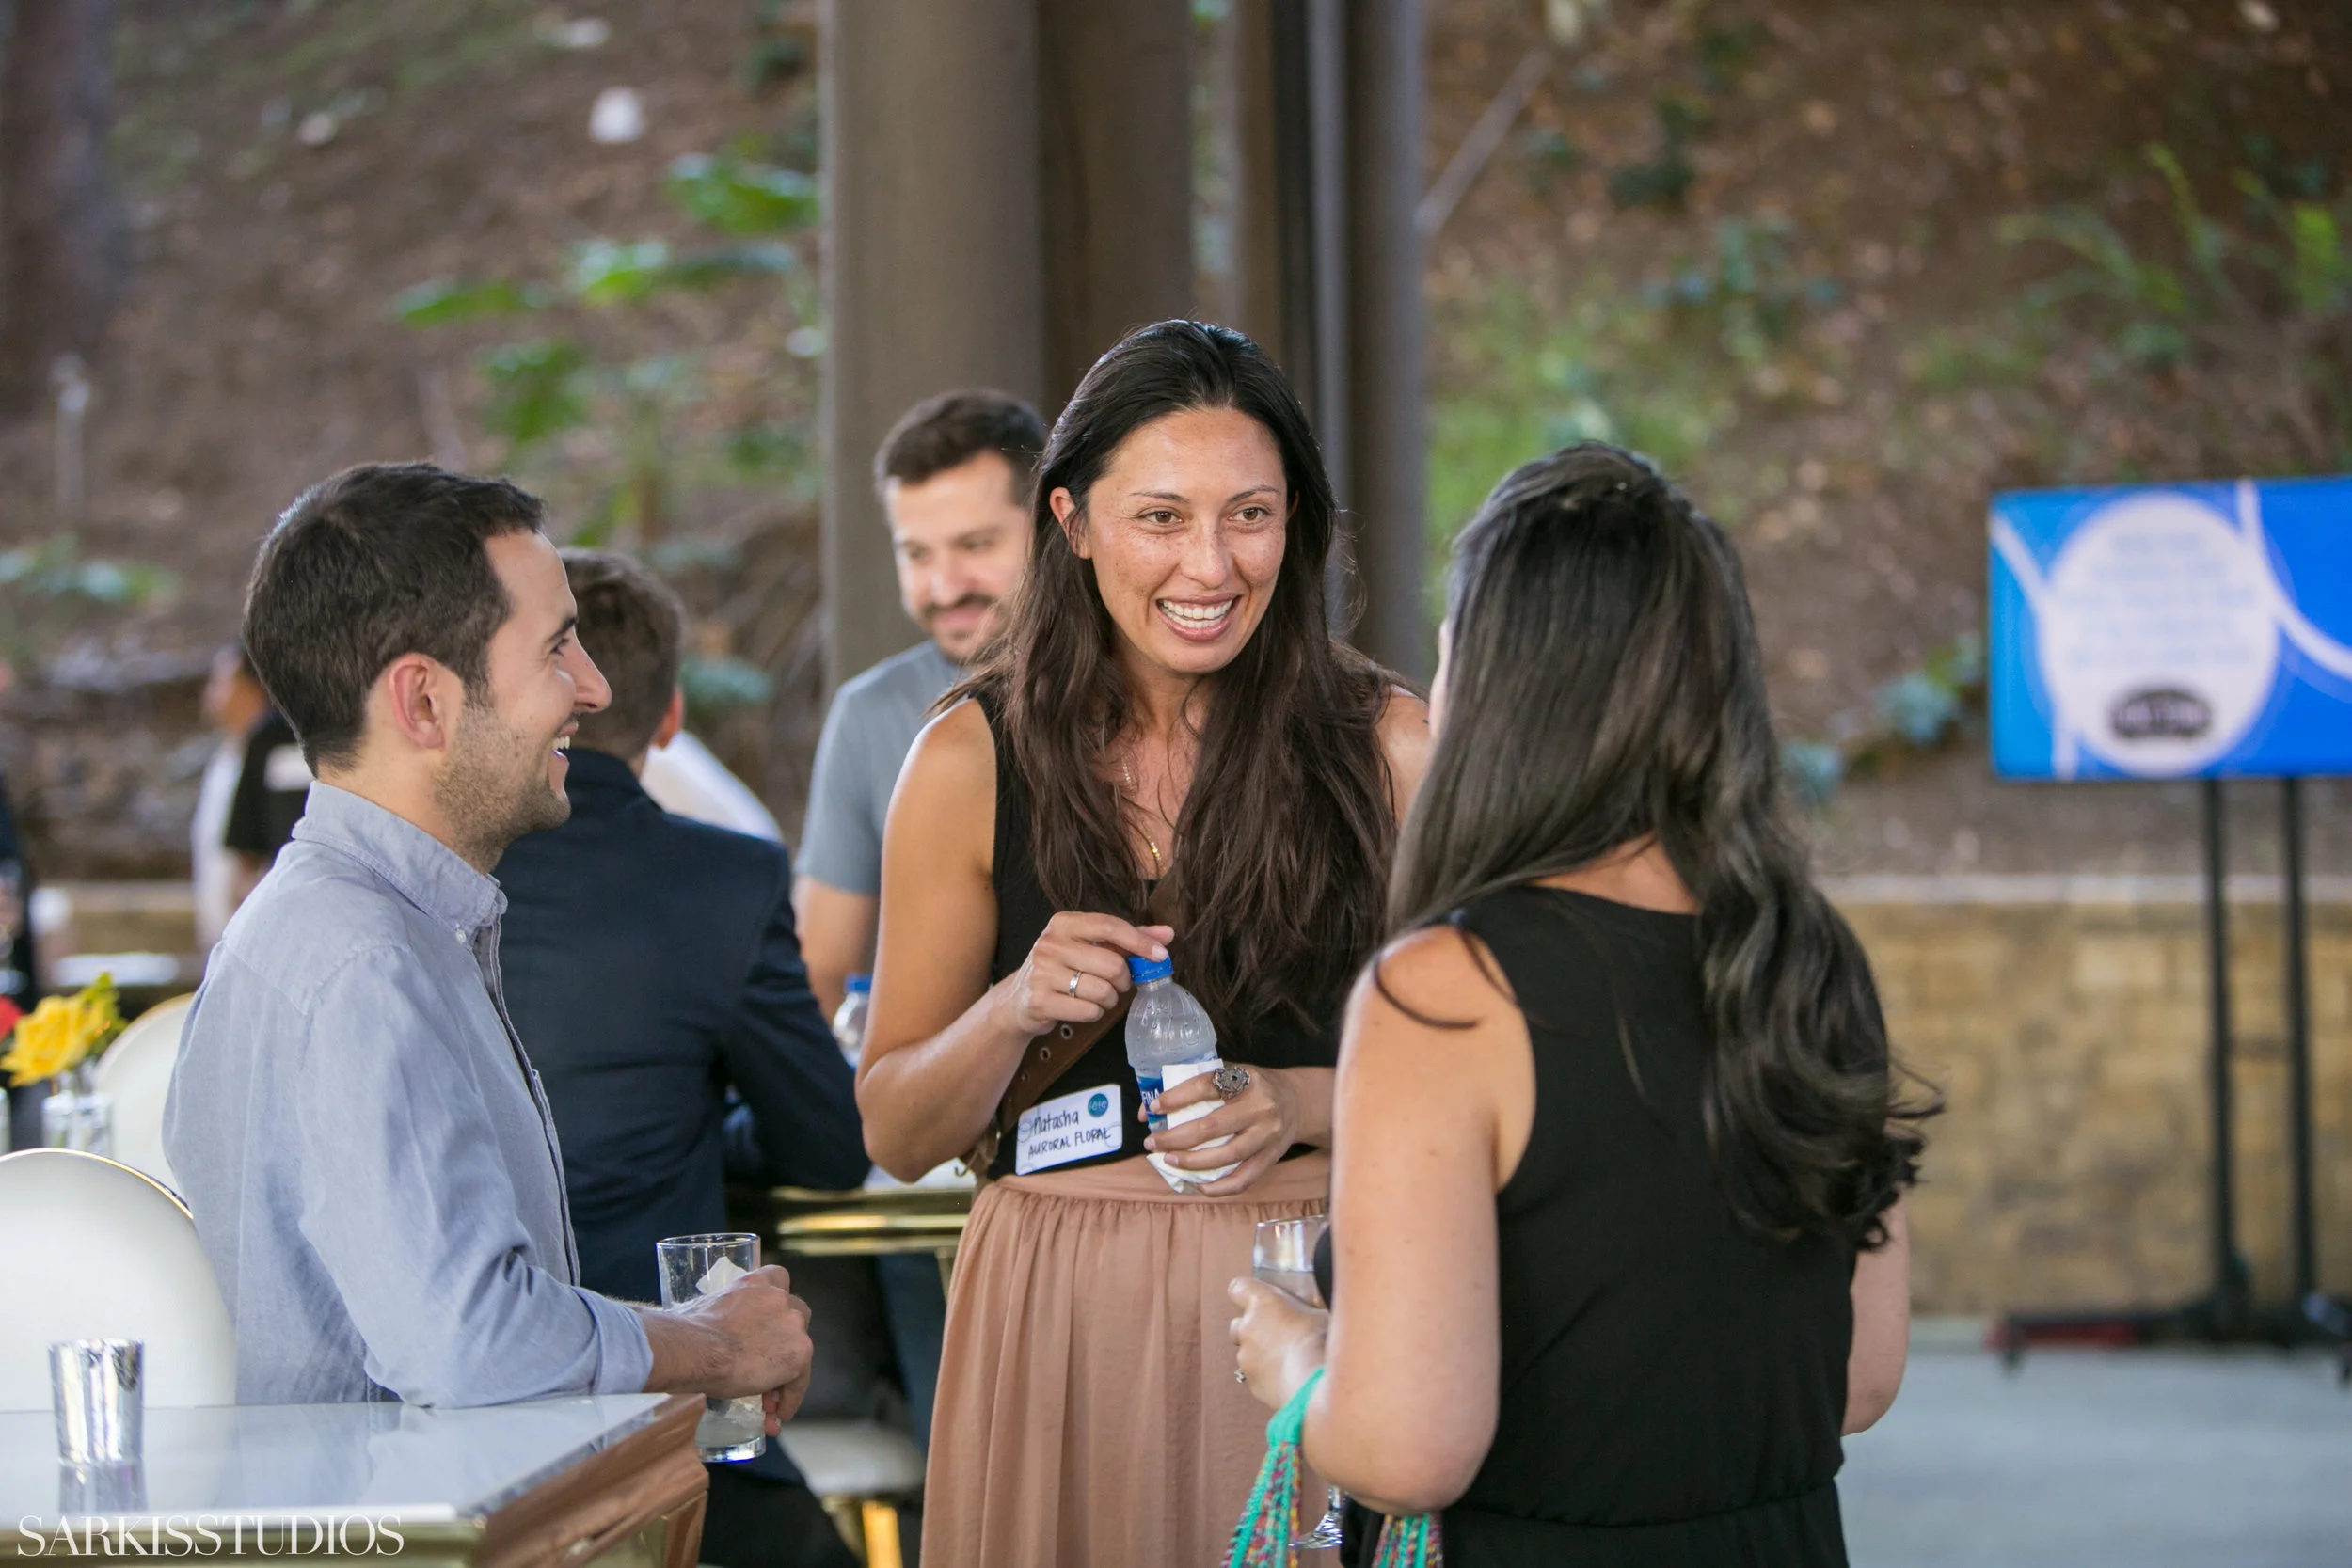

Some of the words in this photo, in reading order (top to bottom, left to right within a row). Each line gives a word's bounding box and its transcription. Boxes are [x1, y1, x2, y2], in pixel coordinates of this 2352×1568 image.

[1033, 1110, 1079, 1136] Natasha
[1028, 1136, 1071, 1159] AURORAL
[1074, 1127, 1111, 1146] FLORAL
